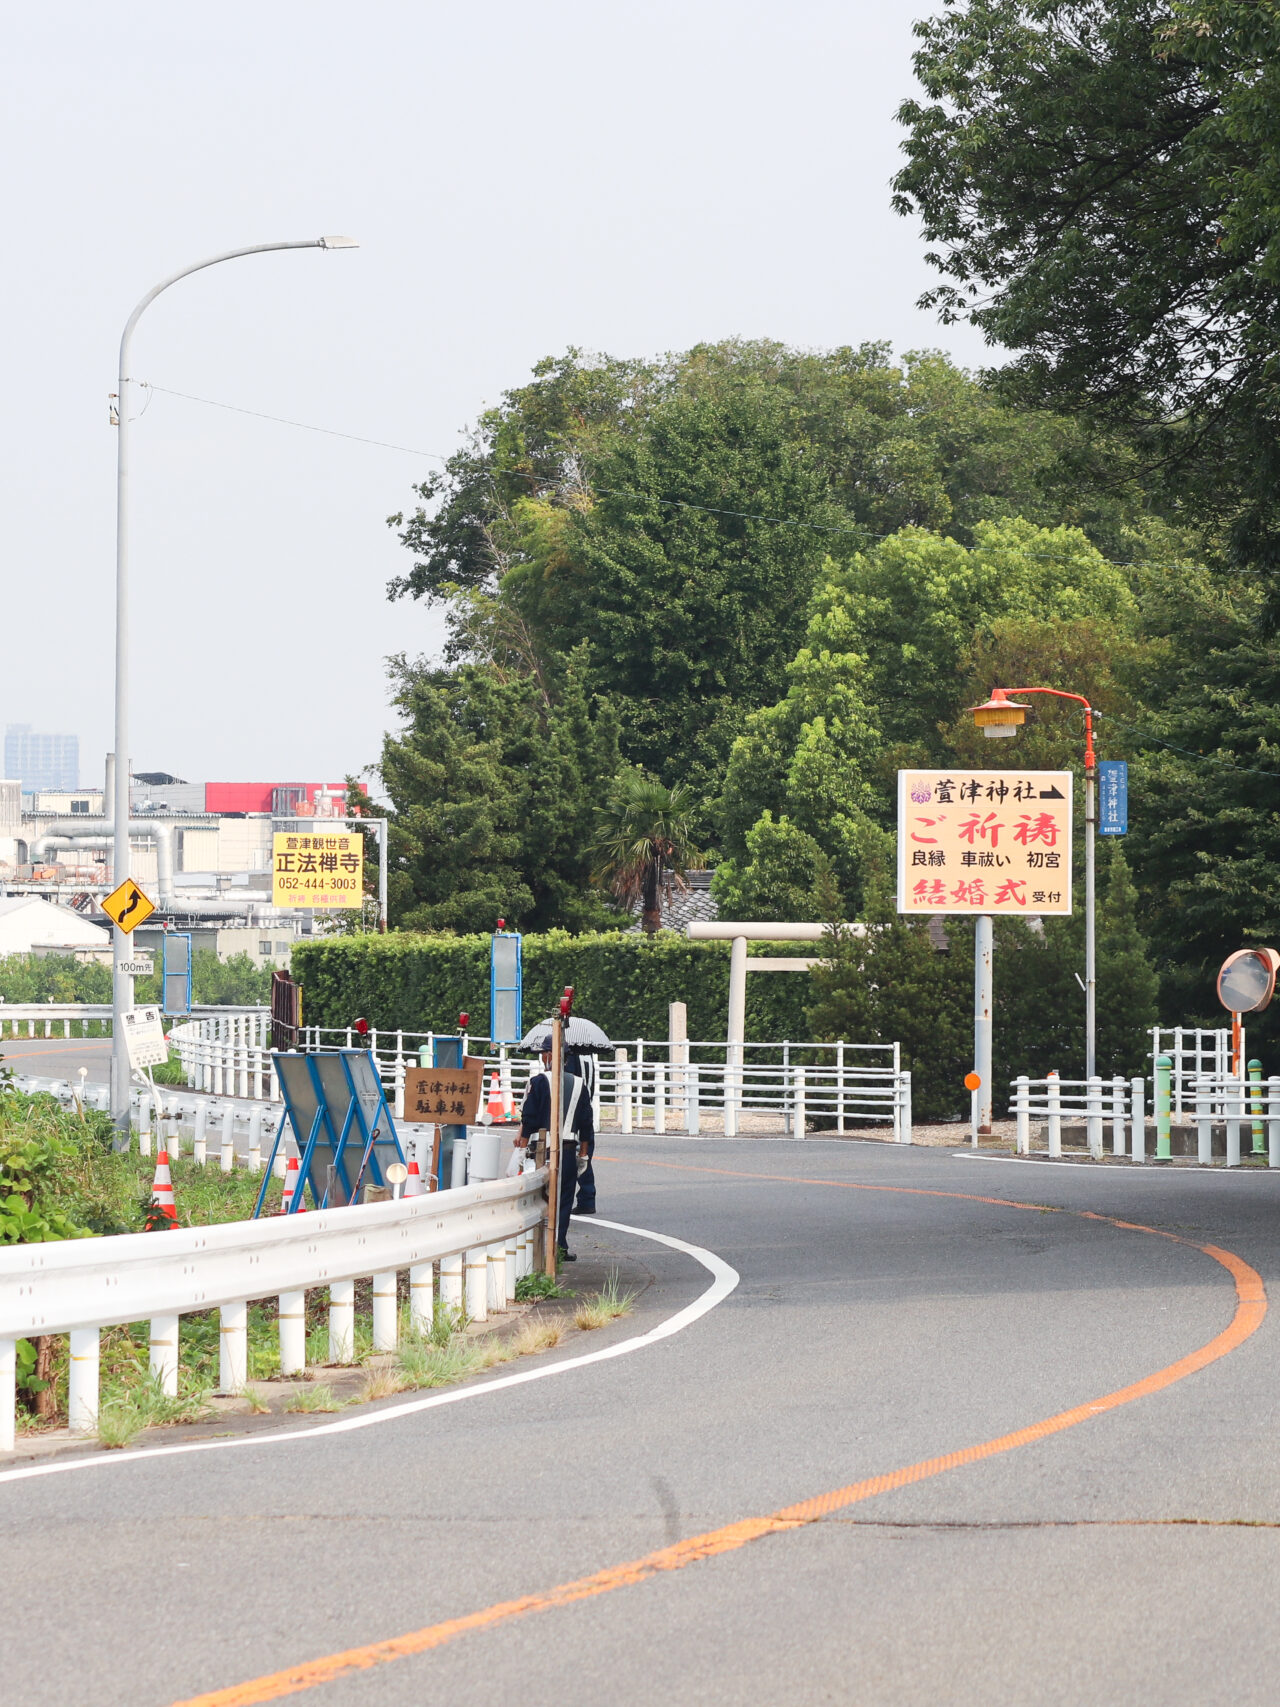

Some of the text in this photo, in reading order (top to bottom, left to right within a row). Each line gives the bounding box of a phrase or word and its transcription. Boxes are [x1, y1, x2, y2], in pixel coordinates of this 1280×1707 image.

[934, 778, 1037, 805] 萱津神社
[286, 837, 350, 850] 萱津観世音
[276, 852, 360, 874] 正法禅寺
[911, 850, 1061, 868] 良縁 車祓い 初宮
[278, 877, 357, 890] 052-444-3003
[912, 878, 1061, 906] 結婚式 受付
[416, 1080, 472, 1095] 萱津神社
[415, 1099, 466, 1117] 駐車場
